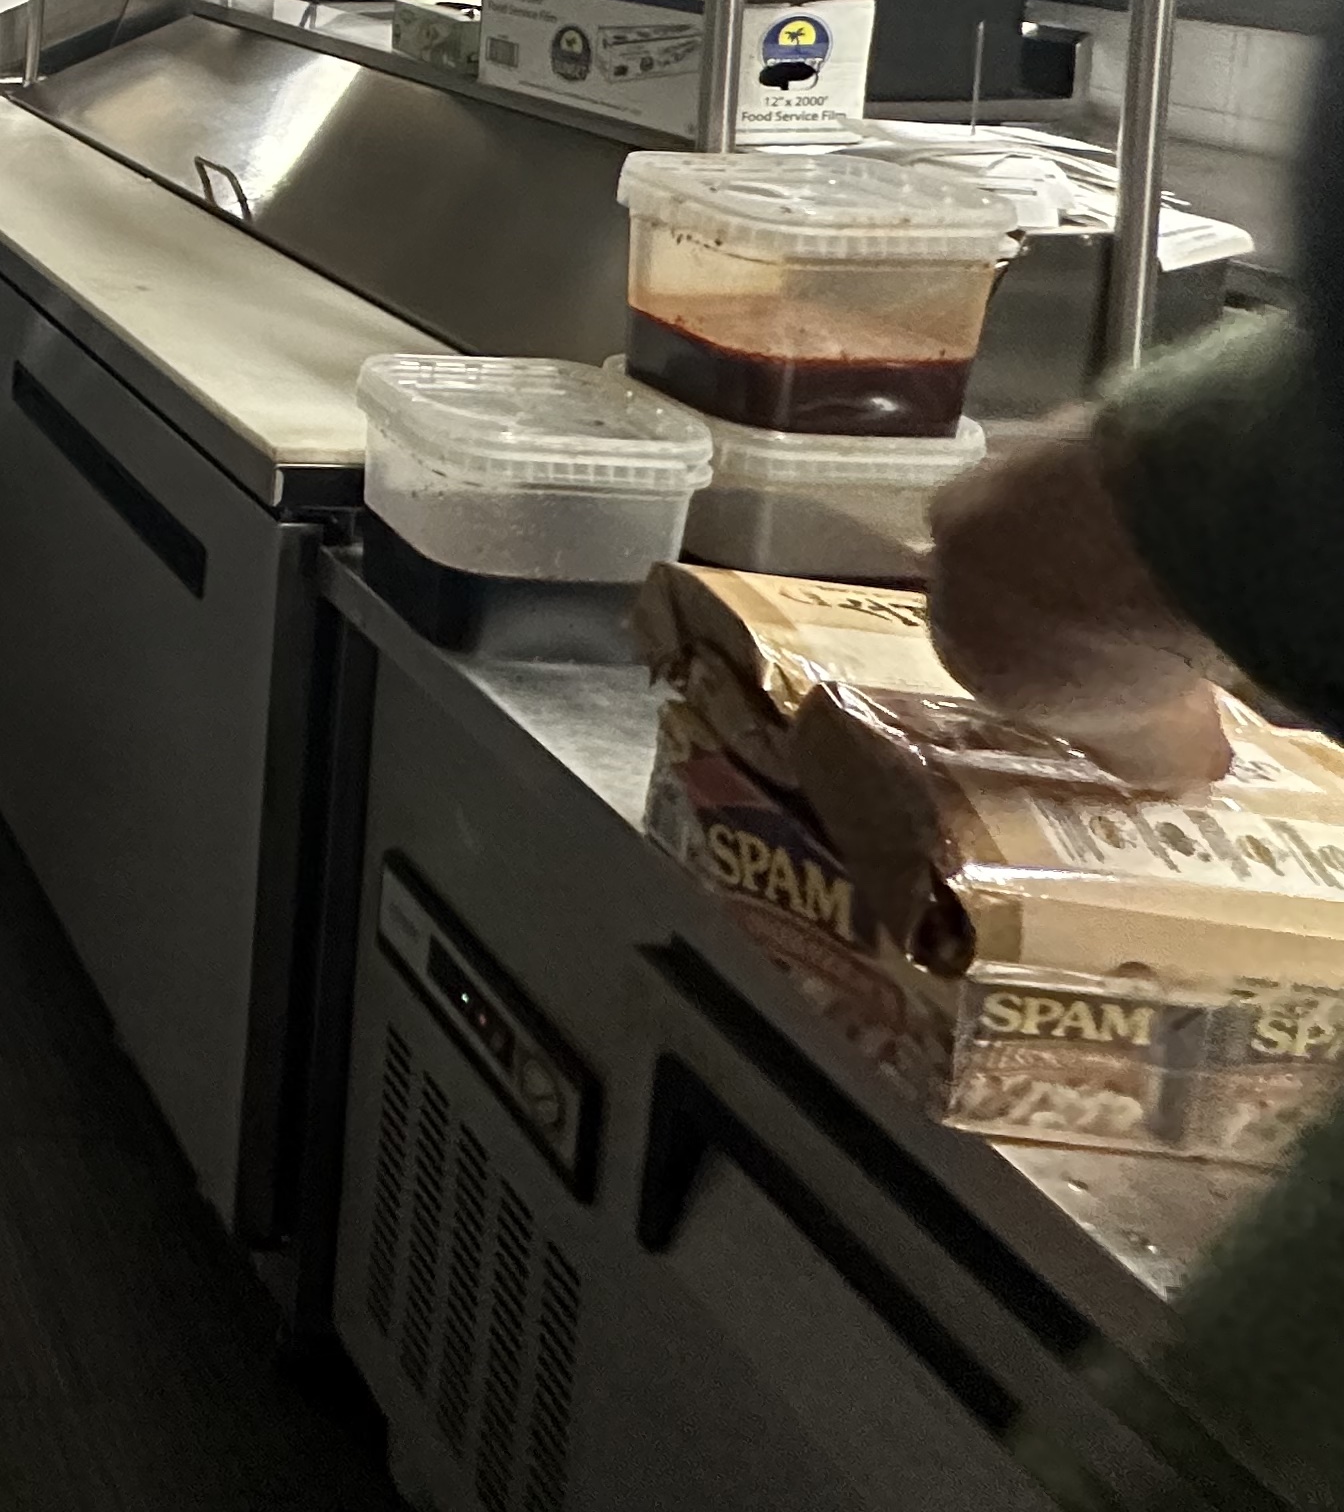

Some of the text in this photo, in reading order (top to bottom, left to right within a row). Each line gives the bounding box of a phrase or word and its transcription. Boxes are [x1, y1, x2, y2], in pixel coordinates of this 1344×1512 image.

[741, 110, 847, 123] Food Service Film
[709, 824, 855, 940] SPAM
[981, 991, 1155, 1046] SPAM
